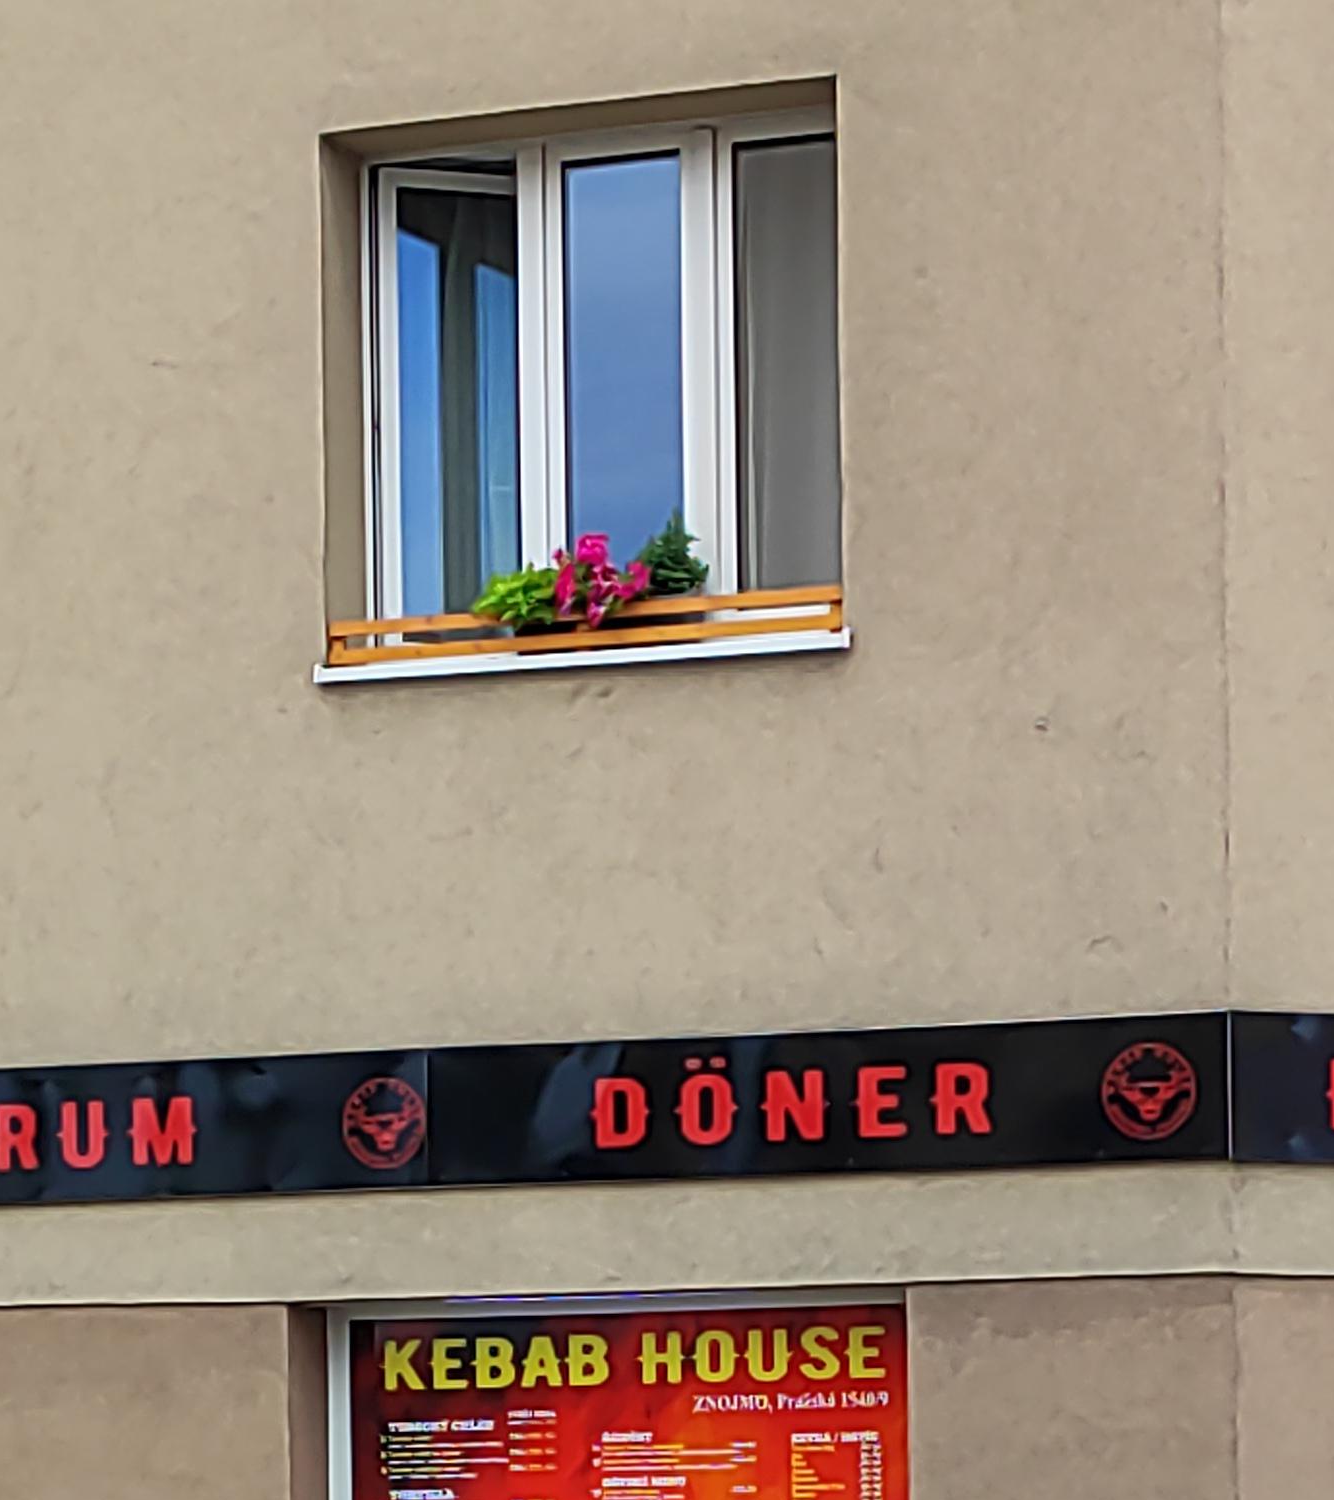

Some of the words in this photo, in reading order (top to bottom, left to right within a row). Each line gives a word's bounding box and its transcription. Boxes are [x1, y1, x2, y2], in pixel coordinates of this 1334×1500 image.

[590, 1057, 992, 1148] DÖNER
[381, 1334, 610, 1391] KEBAB
[637, 1326, 887, 1385] HOUSE
